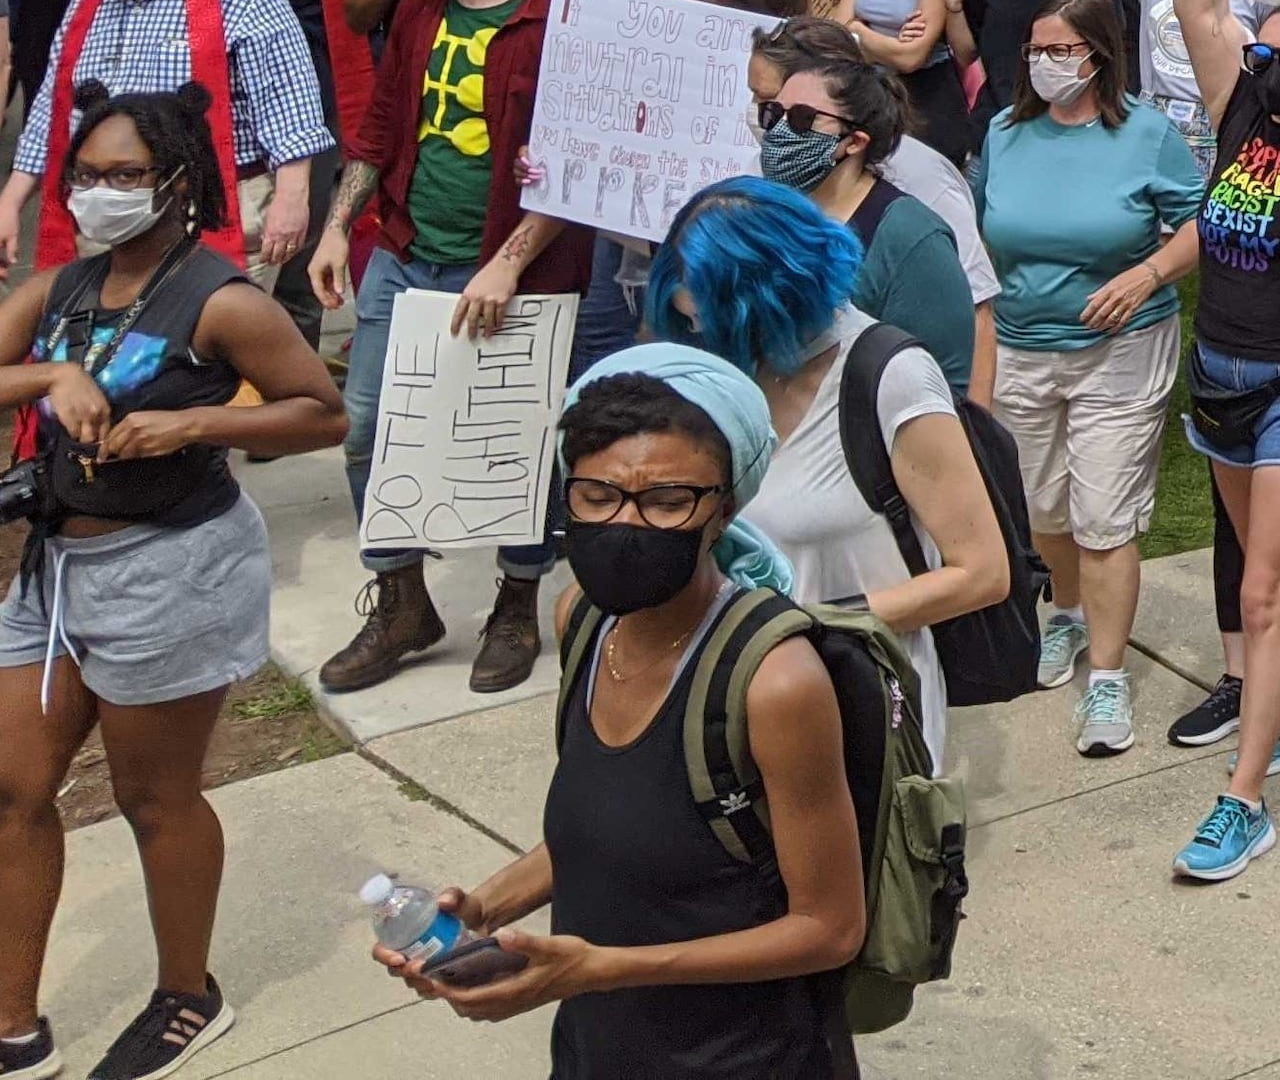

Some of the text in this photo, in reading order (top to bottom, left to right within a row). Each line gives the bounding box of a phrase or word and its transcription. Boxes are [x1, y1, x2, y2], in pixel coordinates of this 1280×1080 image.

[616, 0, 685, 44] you
[702, 56, 739, 108] in
[690, 115, 720, 145] of
[1203, 198, 1275, 238] SEXIST
[1210, 181, 1280, 217] RACIST
[1205, 244, 1270, 272] POTUS
[1240, 234, 1280, 257] MY
[366, 332, 440, 543] DO THE
[422, 298, 552, 543] RIGHT THING
